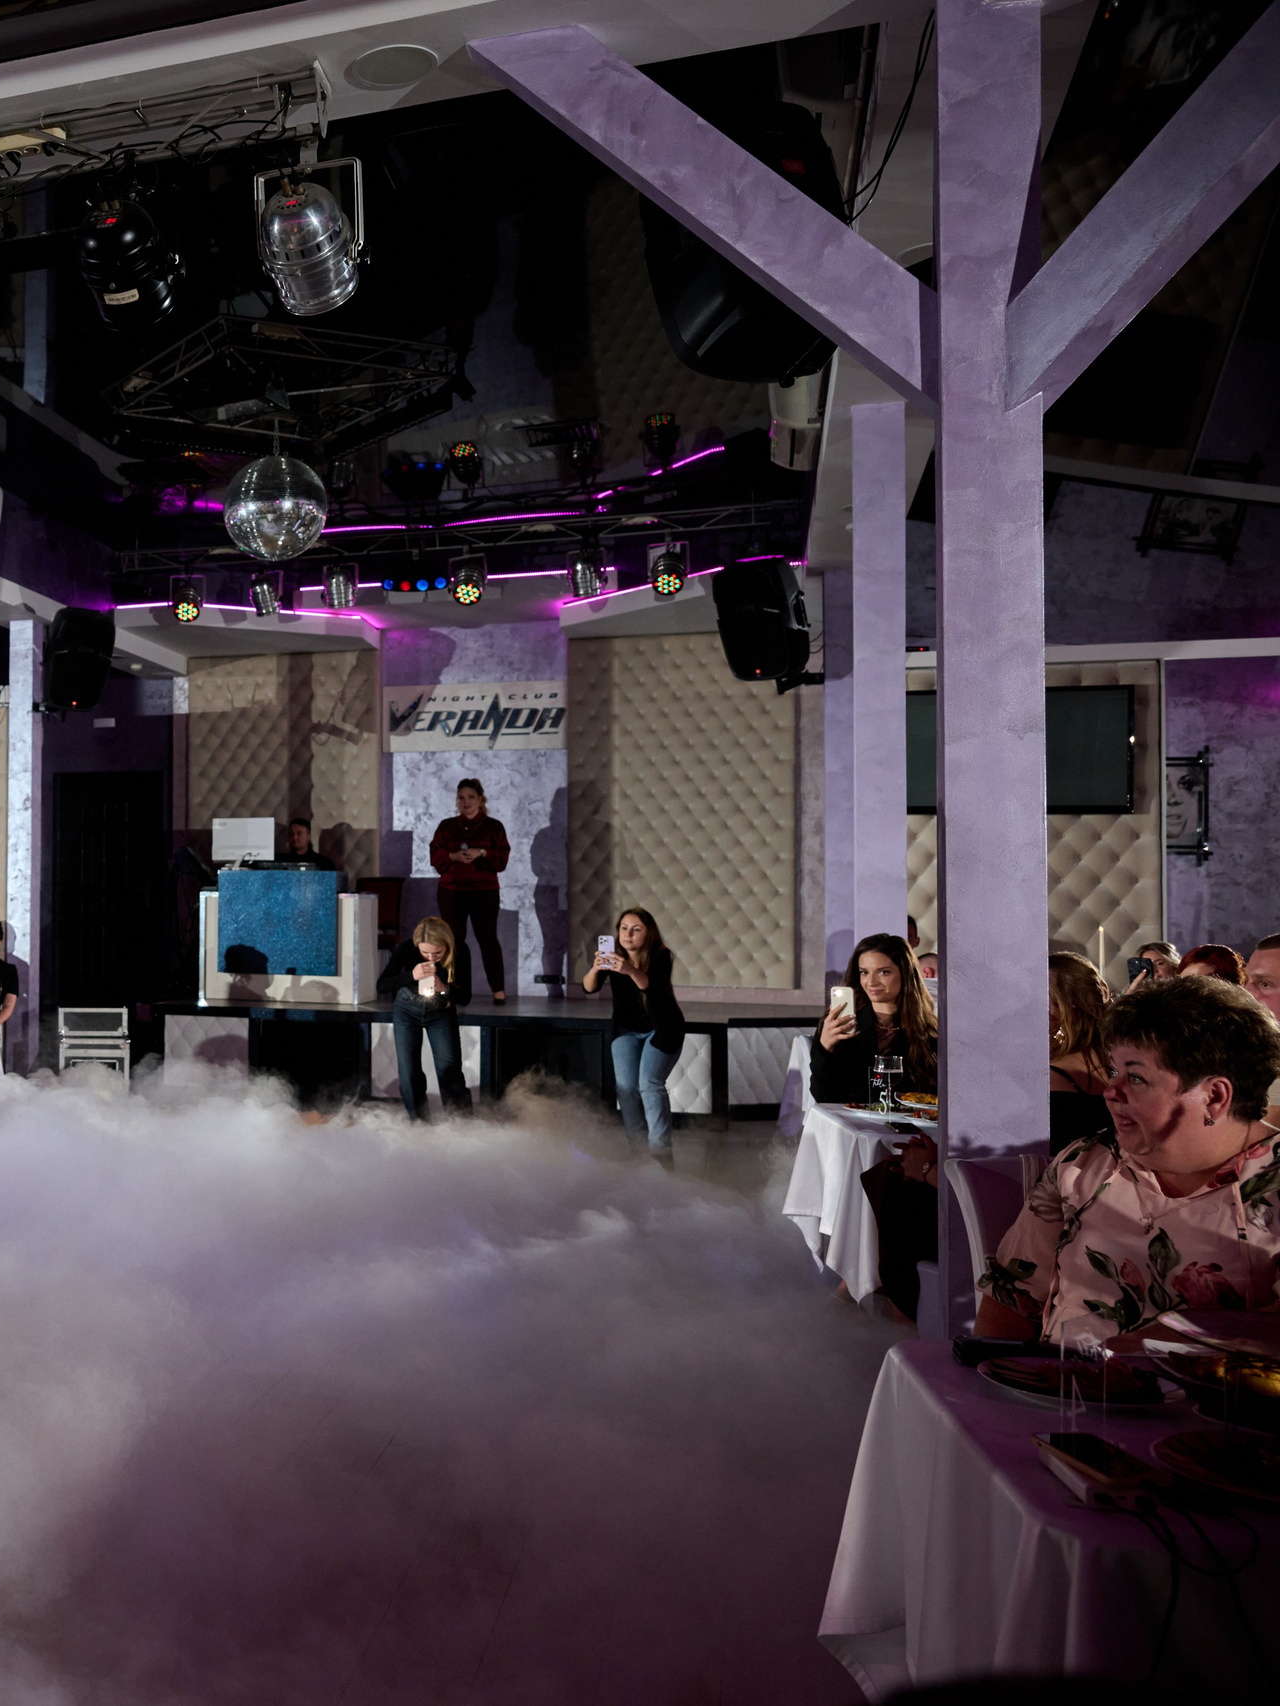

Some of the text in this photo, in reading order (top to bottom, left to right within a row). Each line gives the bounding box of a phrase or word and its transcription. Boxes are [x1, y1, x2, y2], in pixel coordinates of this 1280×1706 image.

[427, 692, 559, 702] NIGHT CLUB
[390, 694, 566, 749] VERANDA
[879, 1090, 887, 1114] 5
